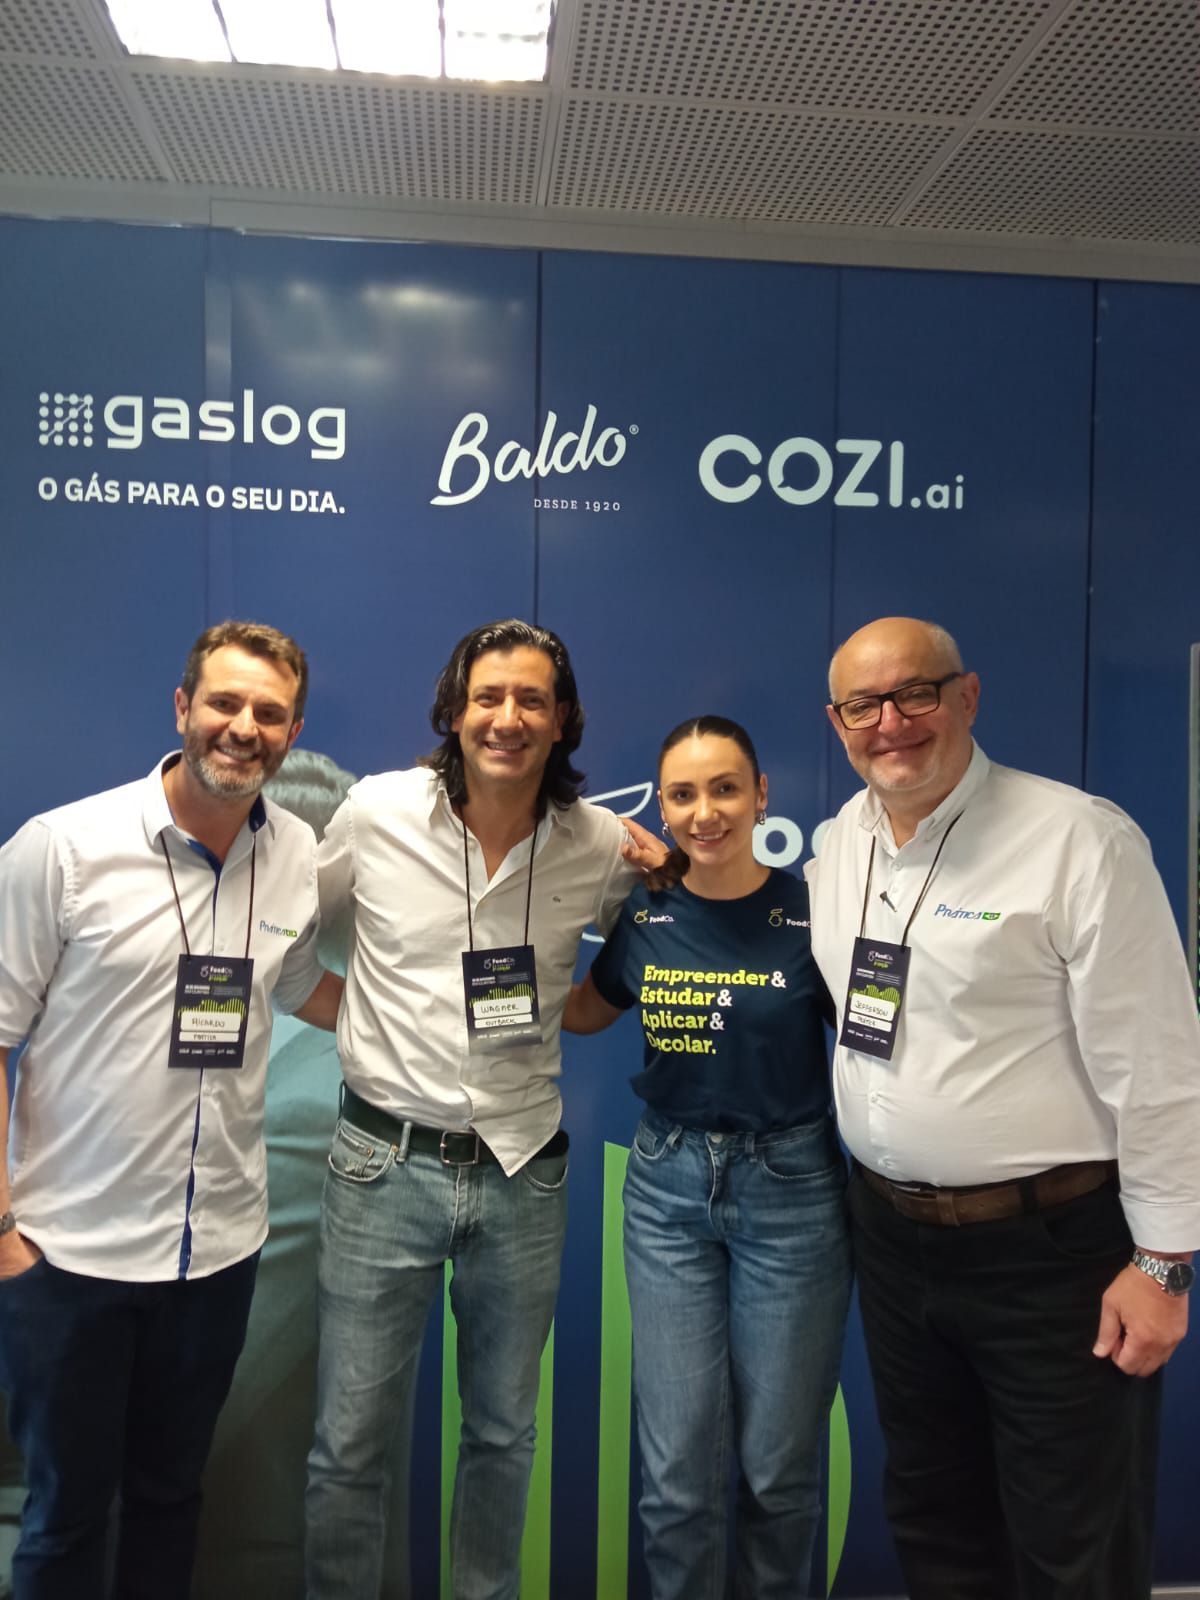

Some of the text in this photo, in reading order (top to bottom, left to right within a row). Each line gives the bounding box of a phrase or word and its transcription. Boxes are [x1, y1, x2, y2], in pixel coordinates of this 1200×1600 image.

[104, 389, 346, 460] gaslog
[698, 433, 964, 508] COZI.ai
[38, 472, 346, 514] O GÁS PARA O SEU DIA.
[533, 498, 621, 513] DESDE 1920
[644, 965, 786, 988] Empreender &
[640, 986, 732, 1007] Estudar &
[642, 1009, 725, 1032] Aplicar &
